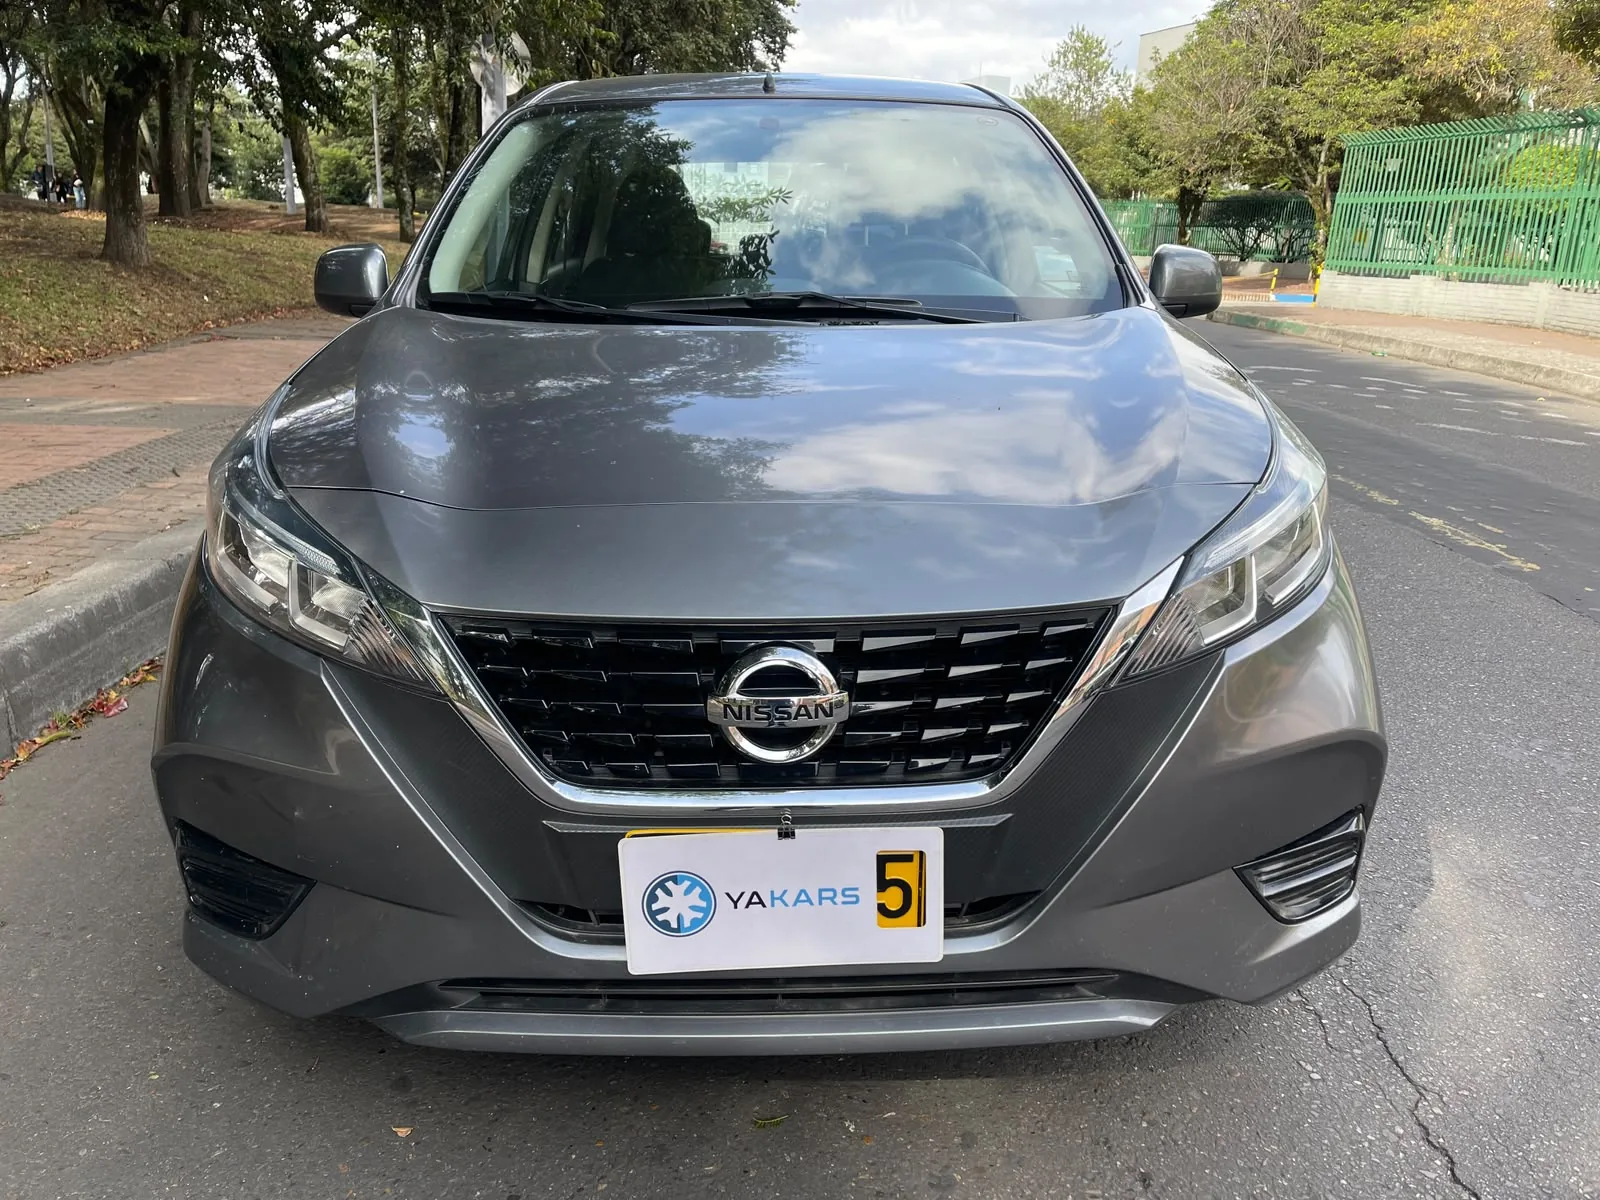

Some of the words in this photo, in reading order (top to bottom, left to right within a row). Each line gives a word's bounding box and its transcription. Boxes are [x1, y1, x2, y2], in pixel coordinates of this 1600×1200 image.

[723, 704, 834, 721] NISSAN
[876, 854, 913, 919] 5
[724, 887, 861, 910] YAKARS
